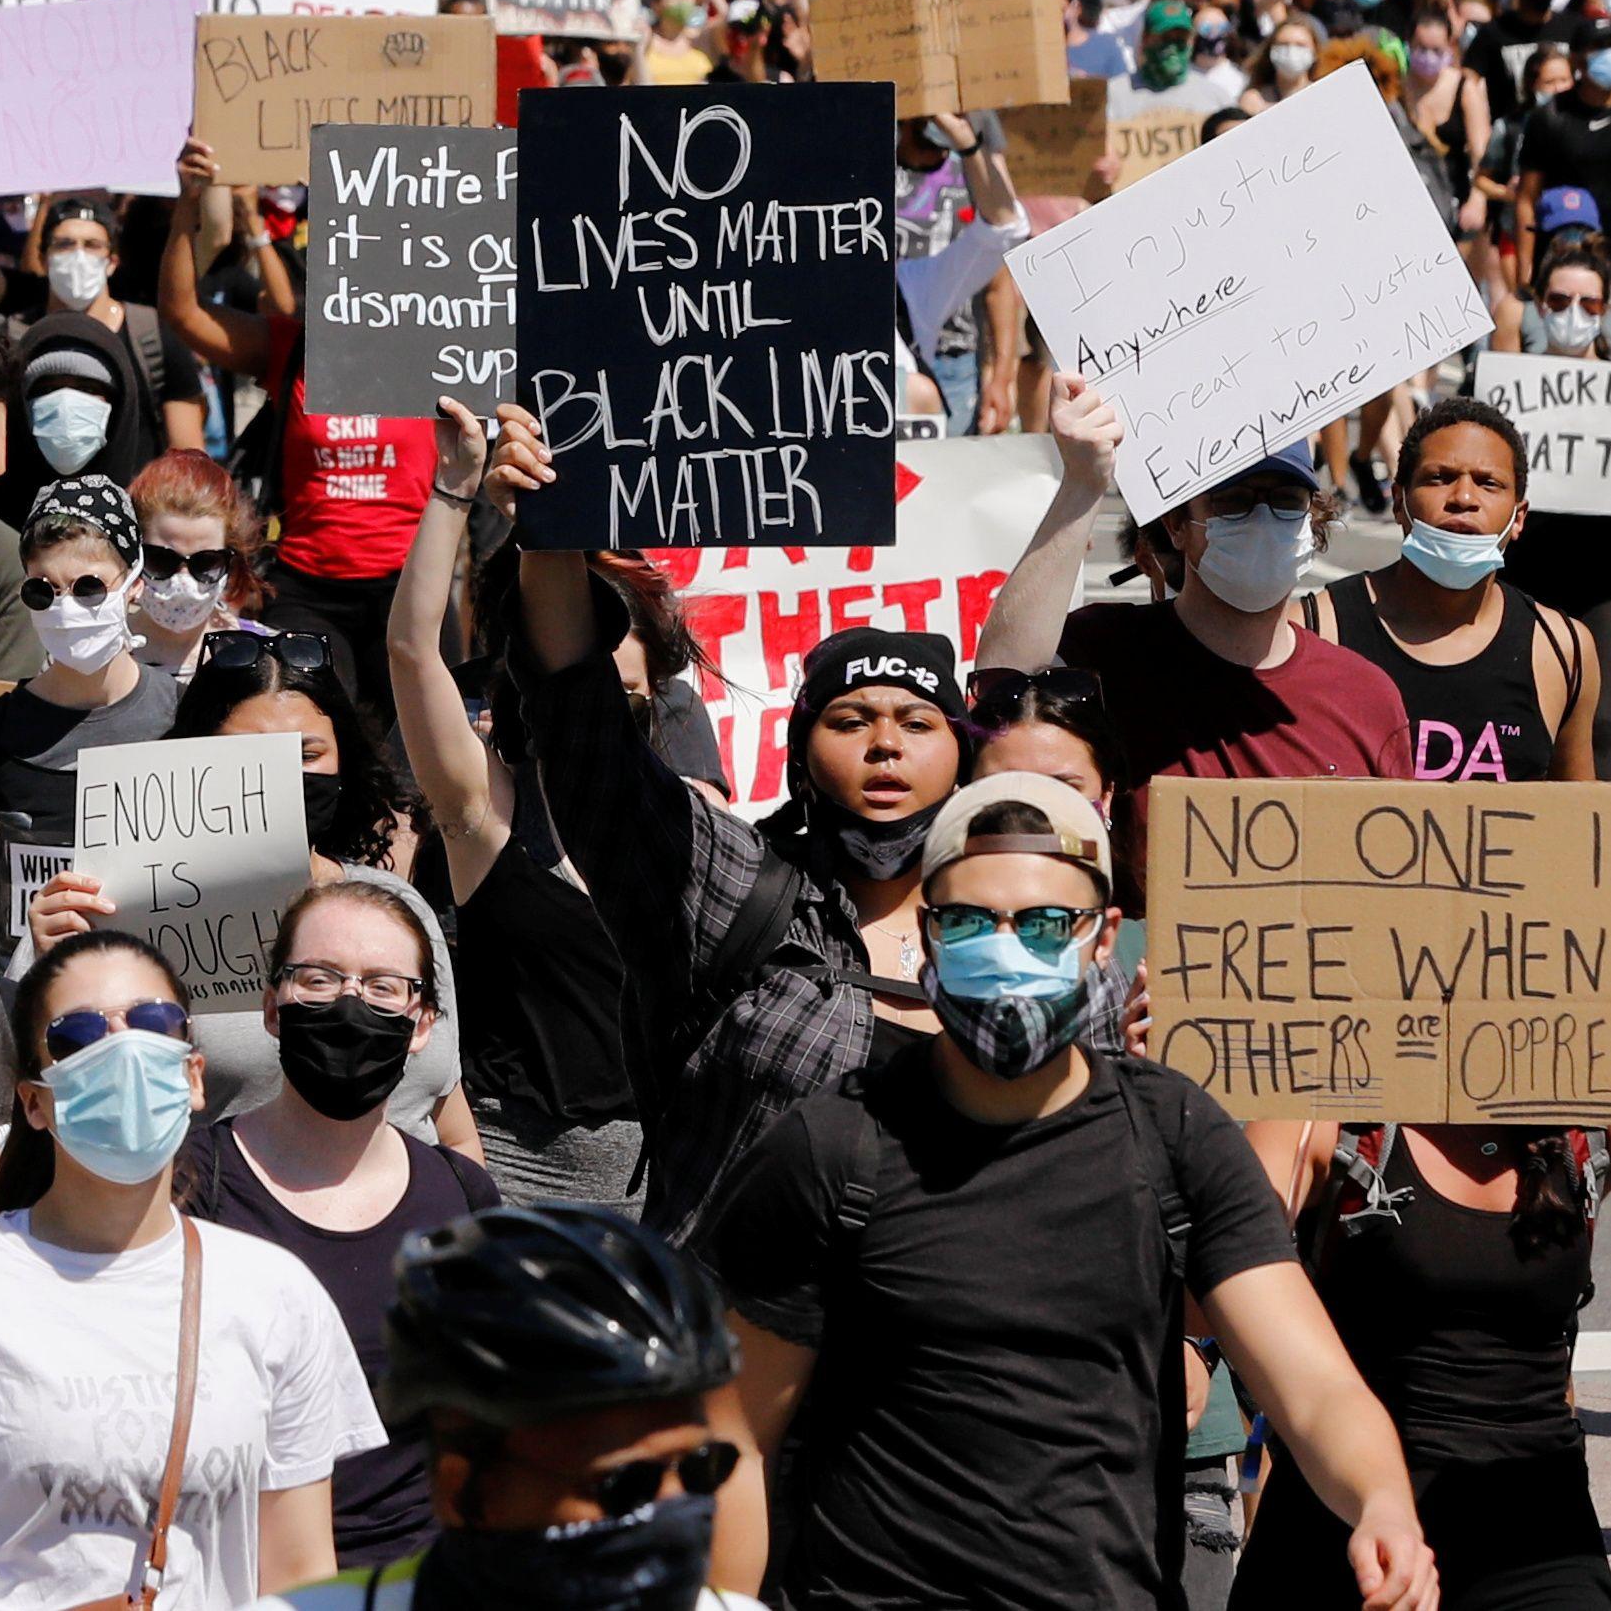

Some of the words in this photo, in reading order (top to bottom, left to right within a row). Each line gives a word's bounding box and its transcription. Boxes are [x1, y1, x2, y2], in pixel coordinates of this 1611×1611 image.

[203, 28, 327, 103] BLACK
[328, 146, 484, 210] White
[618, 104, 753, 211] NO
[328, 225, 381, 269] it
[402, 222, 451, 269] is
[532, 205, 707, 292] LIVES
[716, 197, 888, 269] MATTER
[637, 280, 792, 346] UNTIL
[1077, 273, 1247, 377] Anywhere
[1355, 201, 1377, 222] a
[1271, 319, 1319, 357] to
[531, 352, 756, 456] BLACK
[767, 346, 895, 440] LIVES
[1488, 369, 1598, 415] BLACK
[313, 448, 335, 469] IS
[337, 444, 378, 469] NOT
[381, 444, 397, 468] A
[326, 417, 378, 440] SKIN
[326, 473, 388, 500] CRIME
[608, 443, 824, 550] MATTER
[844, 655, 940, 695] FUC-12
[81, 761, 268, 850] ENOUGH
[19, 852, 76, 885] WHIT
[1186, 794, 1298, 879] NO
[1356, 805, 1535, 890] ONE
[141, 860, 202, 915] IS
[1162, 923, 1354, 1004] FREE
[1390, 910, 1609, 1004] WHEN
[1160, 1013, 1373, 1095] OTHERS
[1396, 1012, 1440, 1040] are
